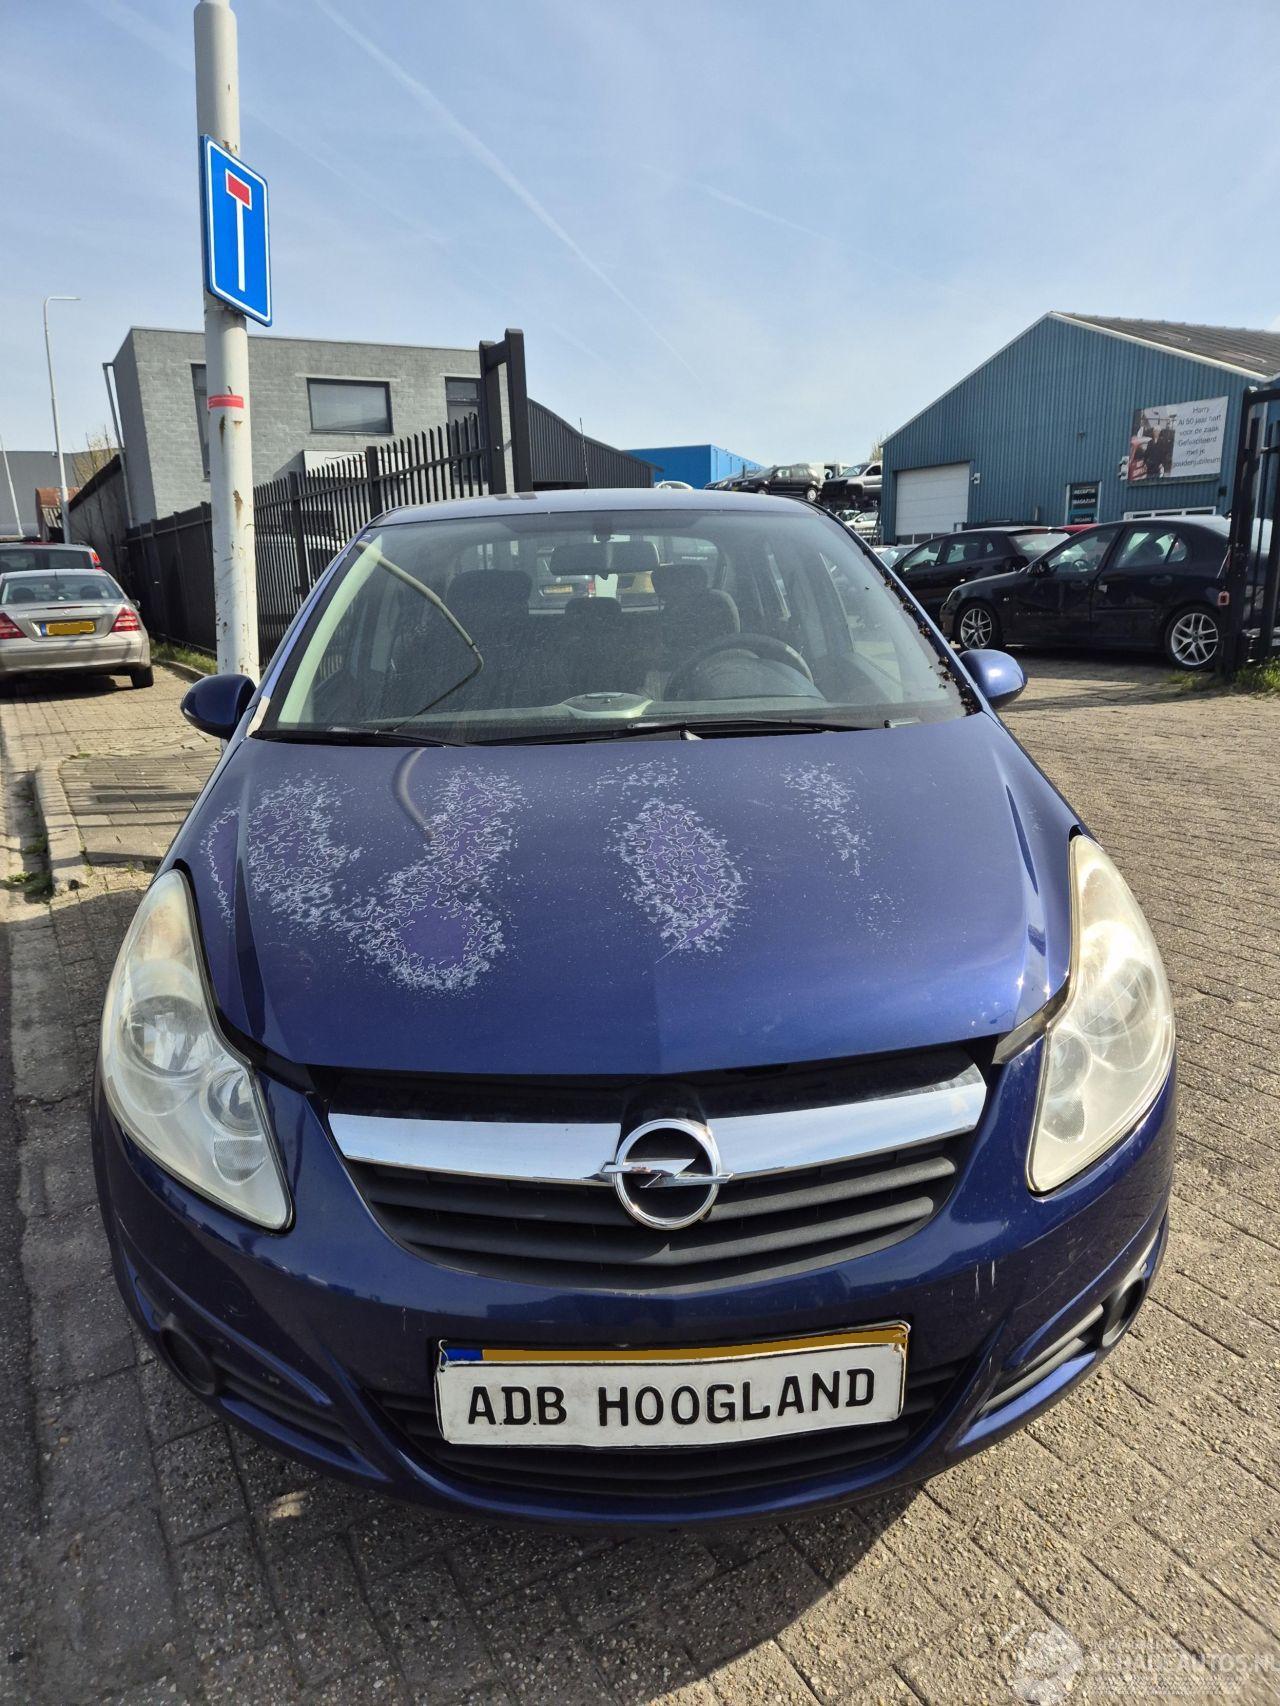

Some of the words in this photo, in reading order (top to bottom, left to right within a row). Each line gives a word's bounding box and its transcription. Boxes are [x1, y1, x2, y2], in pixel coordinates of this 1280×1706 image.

[1192, 406, 1209, 414] Harry
[1186, 417, 1194, 425] 50
[1195, 416, 1207, 425] jaar
[598, 1369, 875, 1426] HOOGLAND
